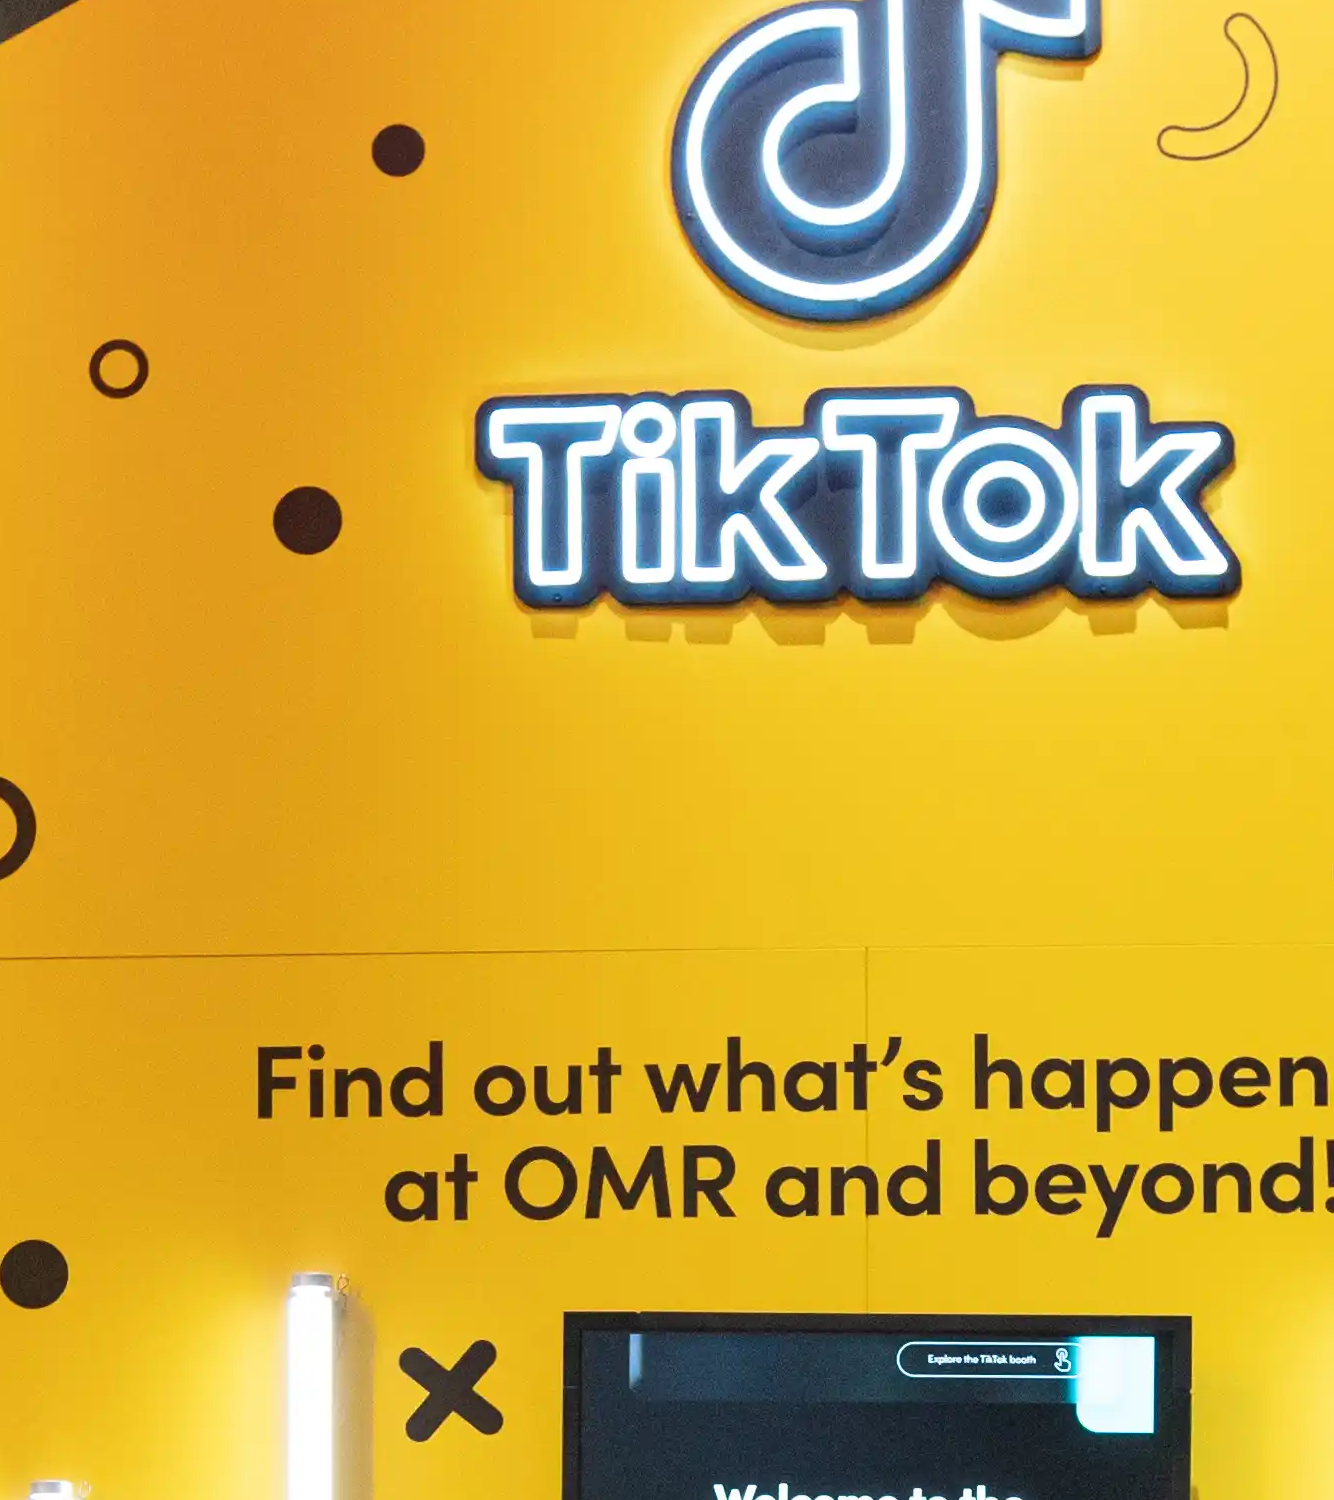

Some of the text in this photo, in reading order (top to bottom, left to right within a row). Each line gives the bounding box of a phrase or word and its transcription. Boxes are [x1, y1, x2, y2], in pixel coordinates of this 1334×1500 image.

[477, 385, 1240, 607] TikTok
[258, 1041, 443, 1119] Find
[474, 1047, 621, 1116] out
[385, 1154, 478, 1222] at
[505, 1145, 736, 1220] OMR
[766, 1139, 940, 1217] and
[928, 1354, 1036, 1365] Explore the TikTok booth
